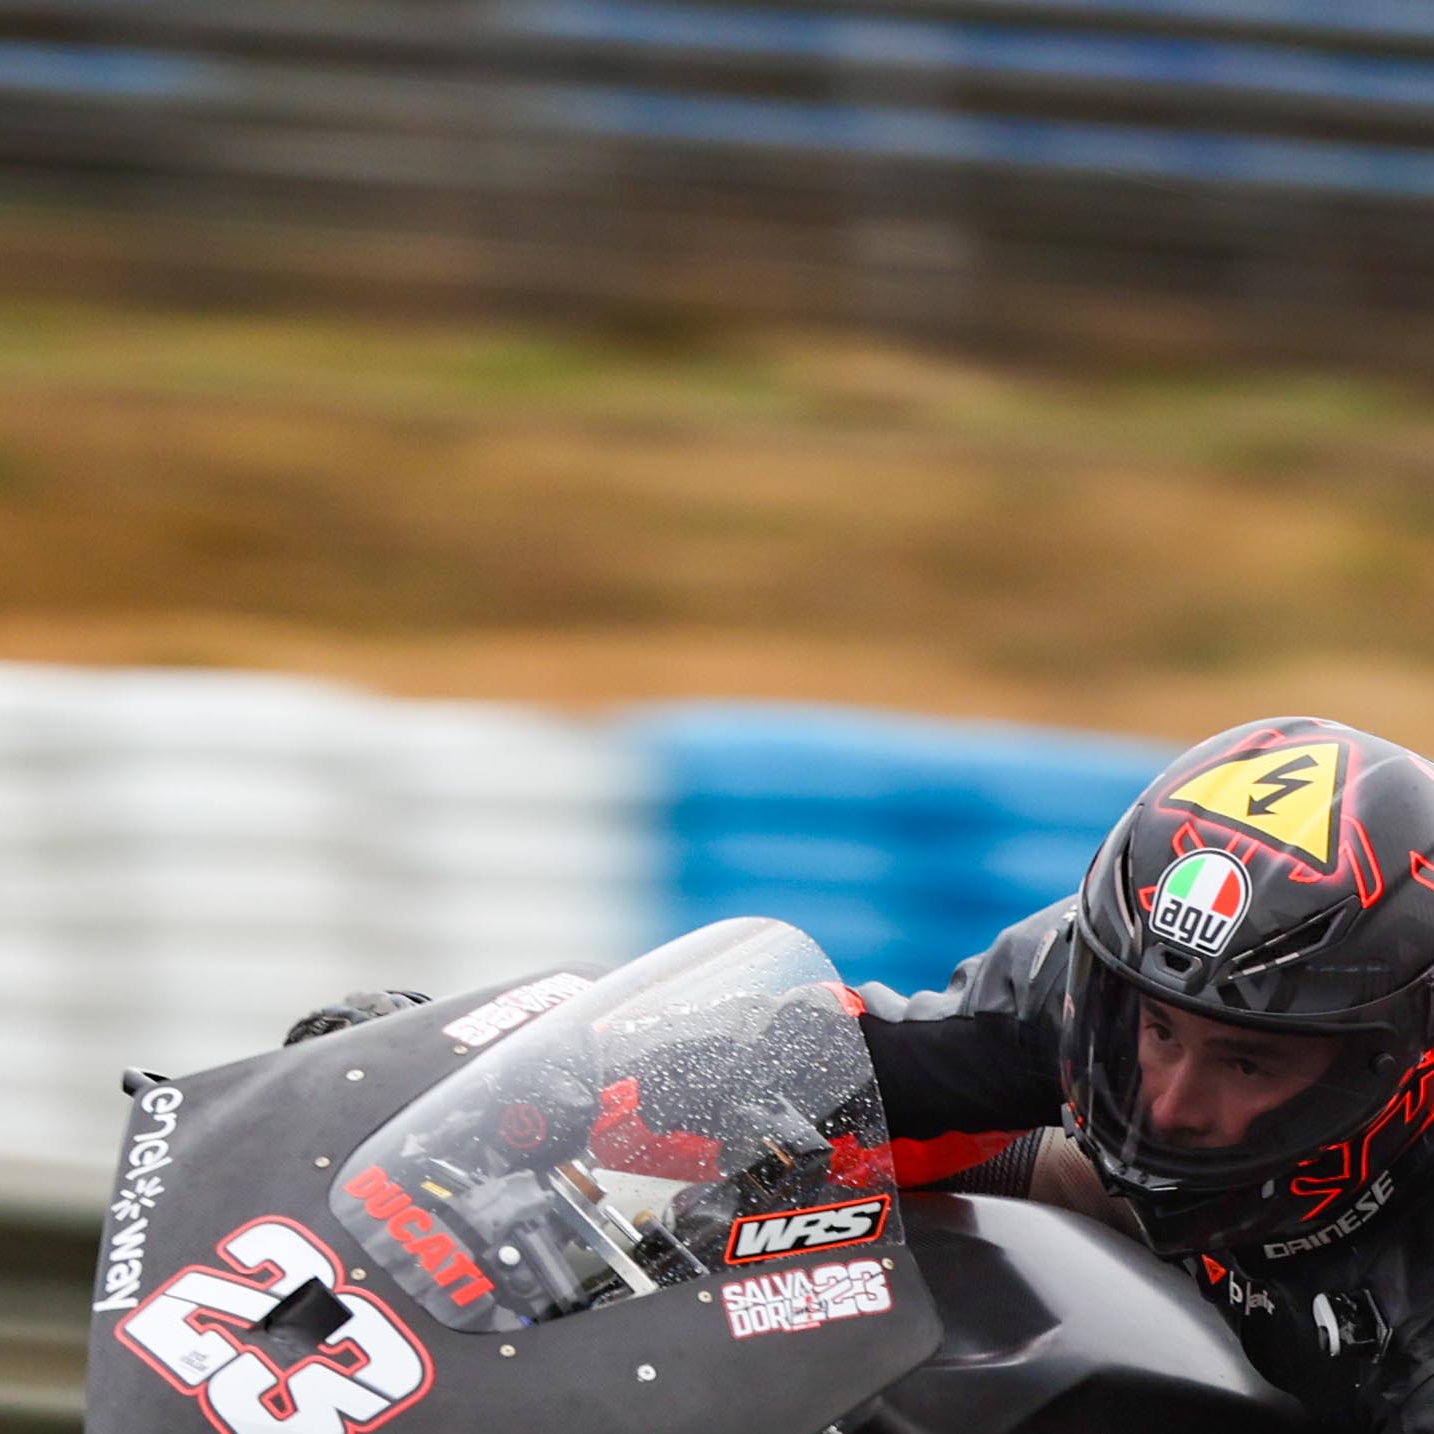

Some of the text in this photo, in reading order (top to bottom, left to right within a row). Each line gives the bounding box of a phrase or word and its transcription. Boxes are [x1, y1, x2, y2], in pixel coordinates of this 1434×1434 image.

[92, 1086, 184, 1312] enel way
[343, 1167, 495, 1306] DUCATI
[735, 1202, 881, 1257] WRS
[1263, 1170, 1395, 1259] DAINESE
[813, 1261, 891, 1319] 23
